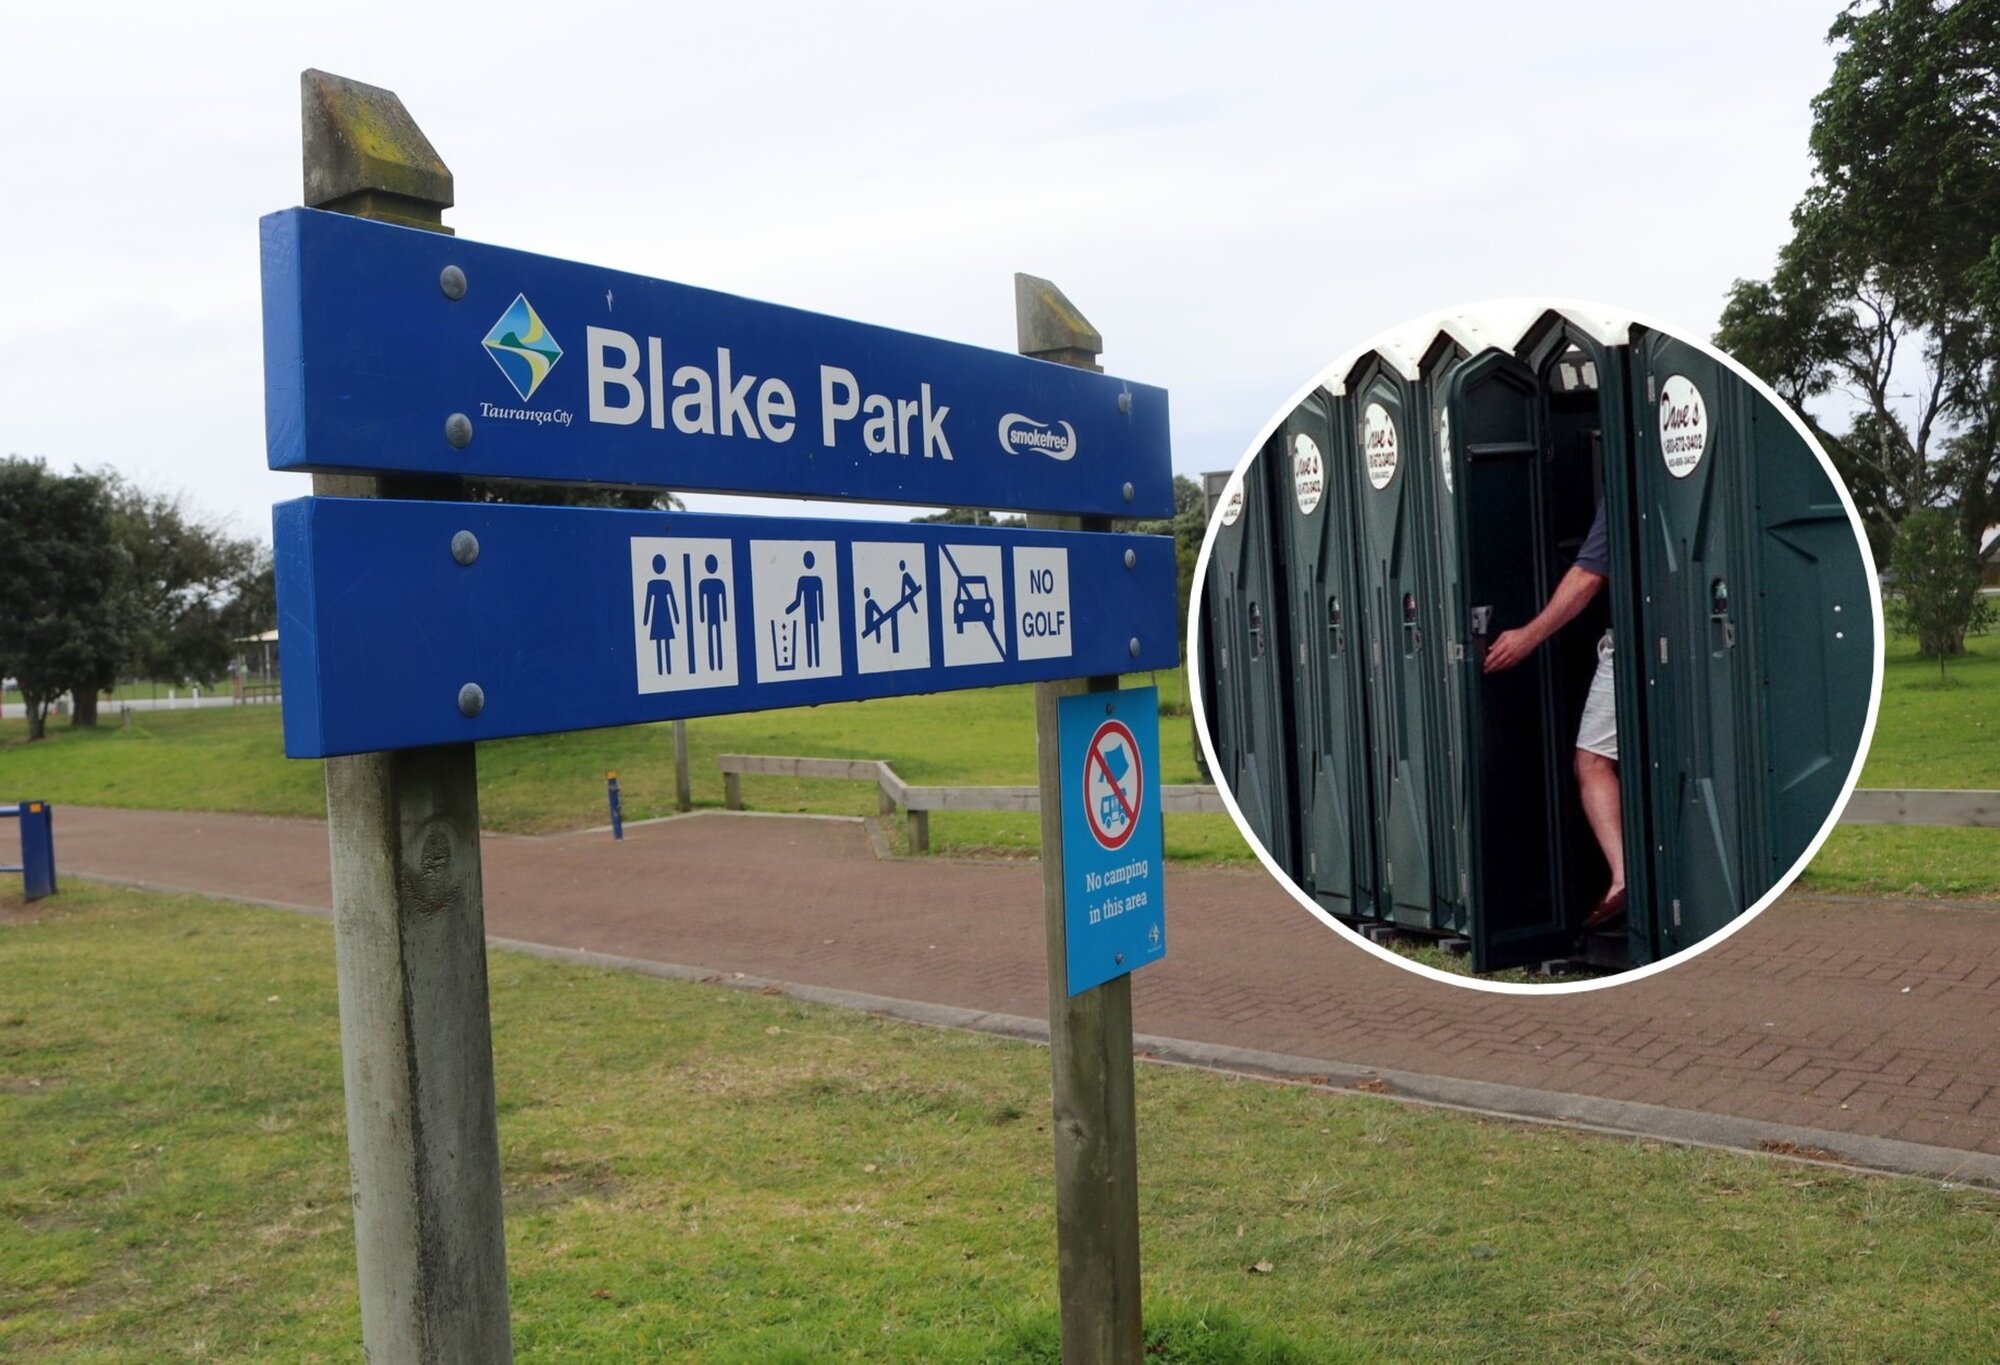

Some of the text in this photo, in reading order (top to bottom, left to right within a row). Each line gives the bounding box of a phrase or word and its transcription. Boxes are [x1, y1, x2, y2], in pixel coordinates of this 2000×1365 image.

[586, 325, 954, 461] Blake Park
[1661, 387, 1700, 432] Dave's
[1010, 428, 1067, 450] smokefree
[1030, 569, 1054, 594] NO
[1022, 611, 1065, 637] GOLF
[1086, 858, 1148, 893] No camping
[1089, 891, 1147, 925] in this area
